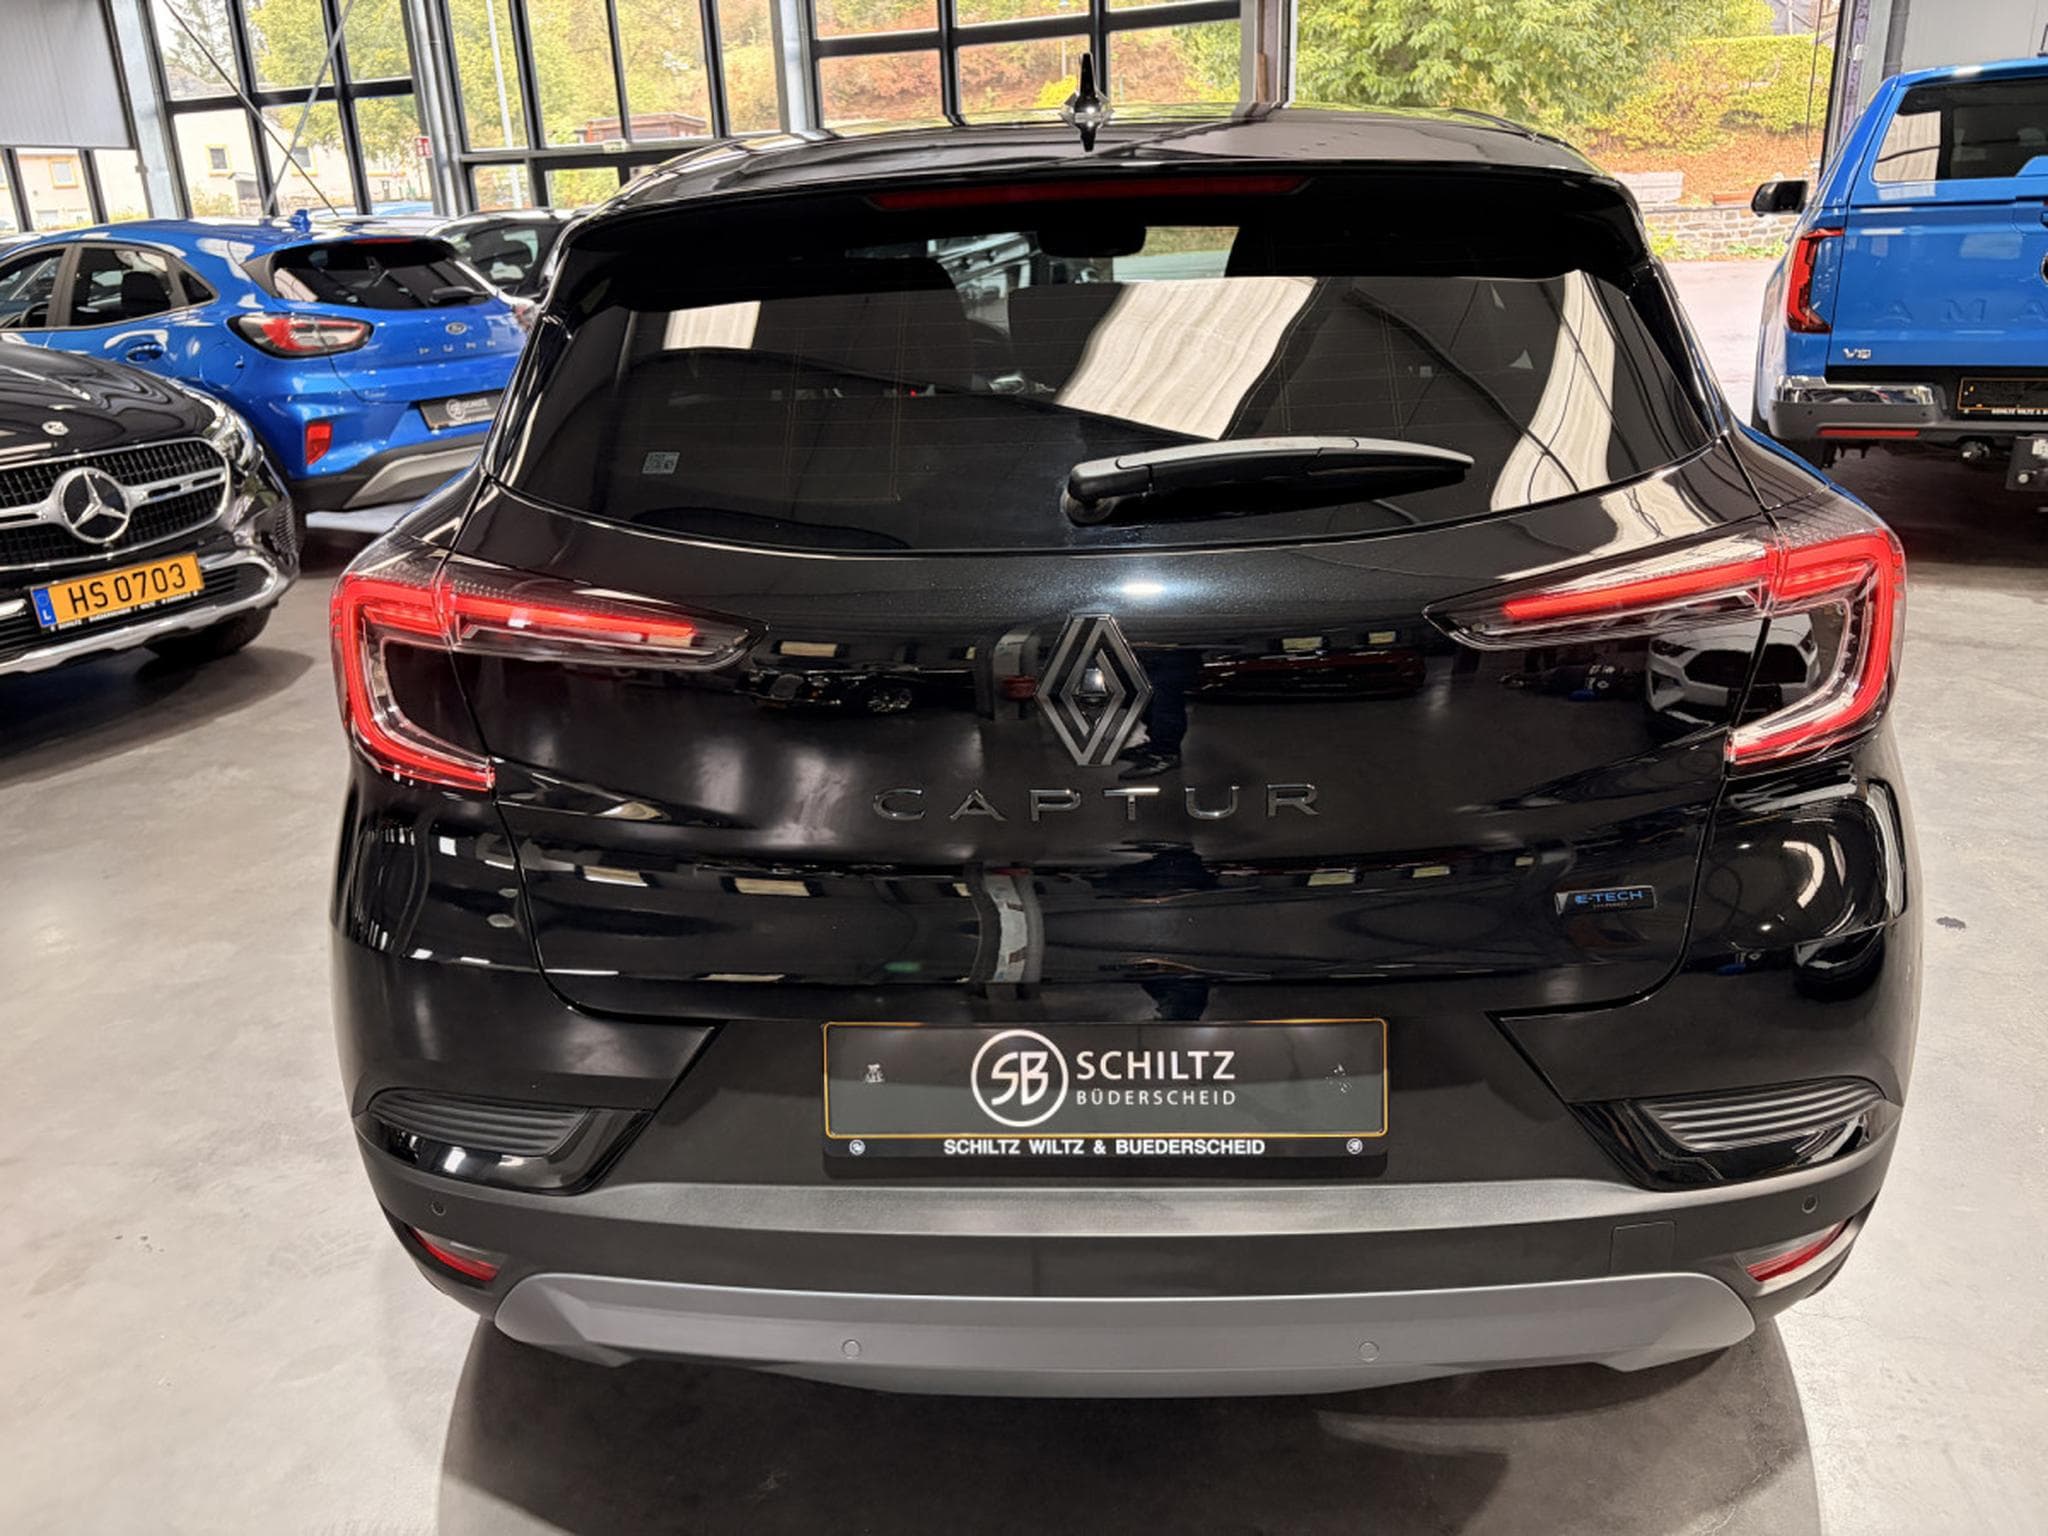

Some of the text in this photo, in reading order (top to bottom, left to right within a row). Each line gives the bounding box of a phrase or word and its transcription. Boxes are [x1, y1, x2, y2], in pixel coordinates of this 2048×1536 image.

[42, 609, 52, 621] L
[67, 580, 109, 614] HS
[113, 562, 186, 603] 0703
[872, 783, 1320, 823] CAPTUR
[1574, 890, 1643, 904] E-TECH
[990, 1050, 1050, 1106] SB
[1075, 1050, 1236, 1081] SCHILTZ
[1076, 1088, 1237, 1106] BÜDERSCHEID
[943, 1138, 1266, 1156] SCHILTZ WILTZ & BUEDERSCHEID
